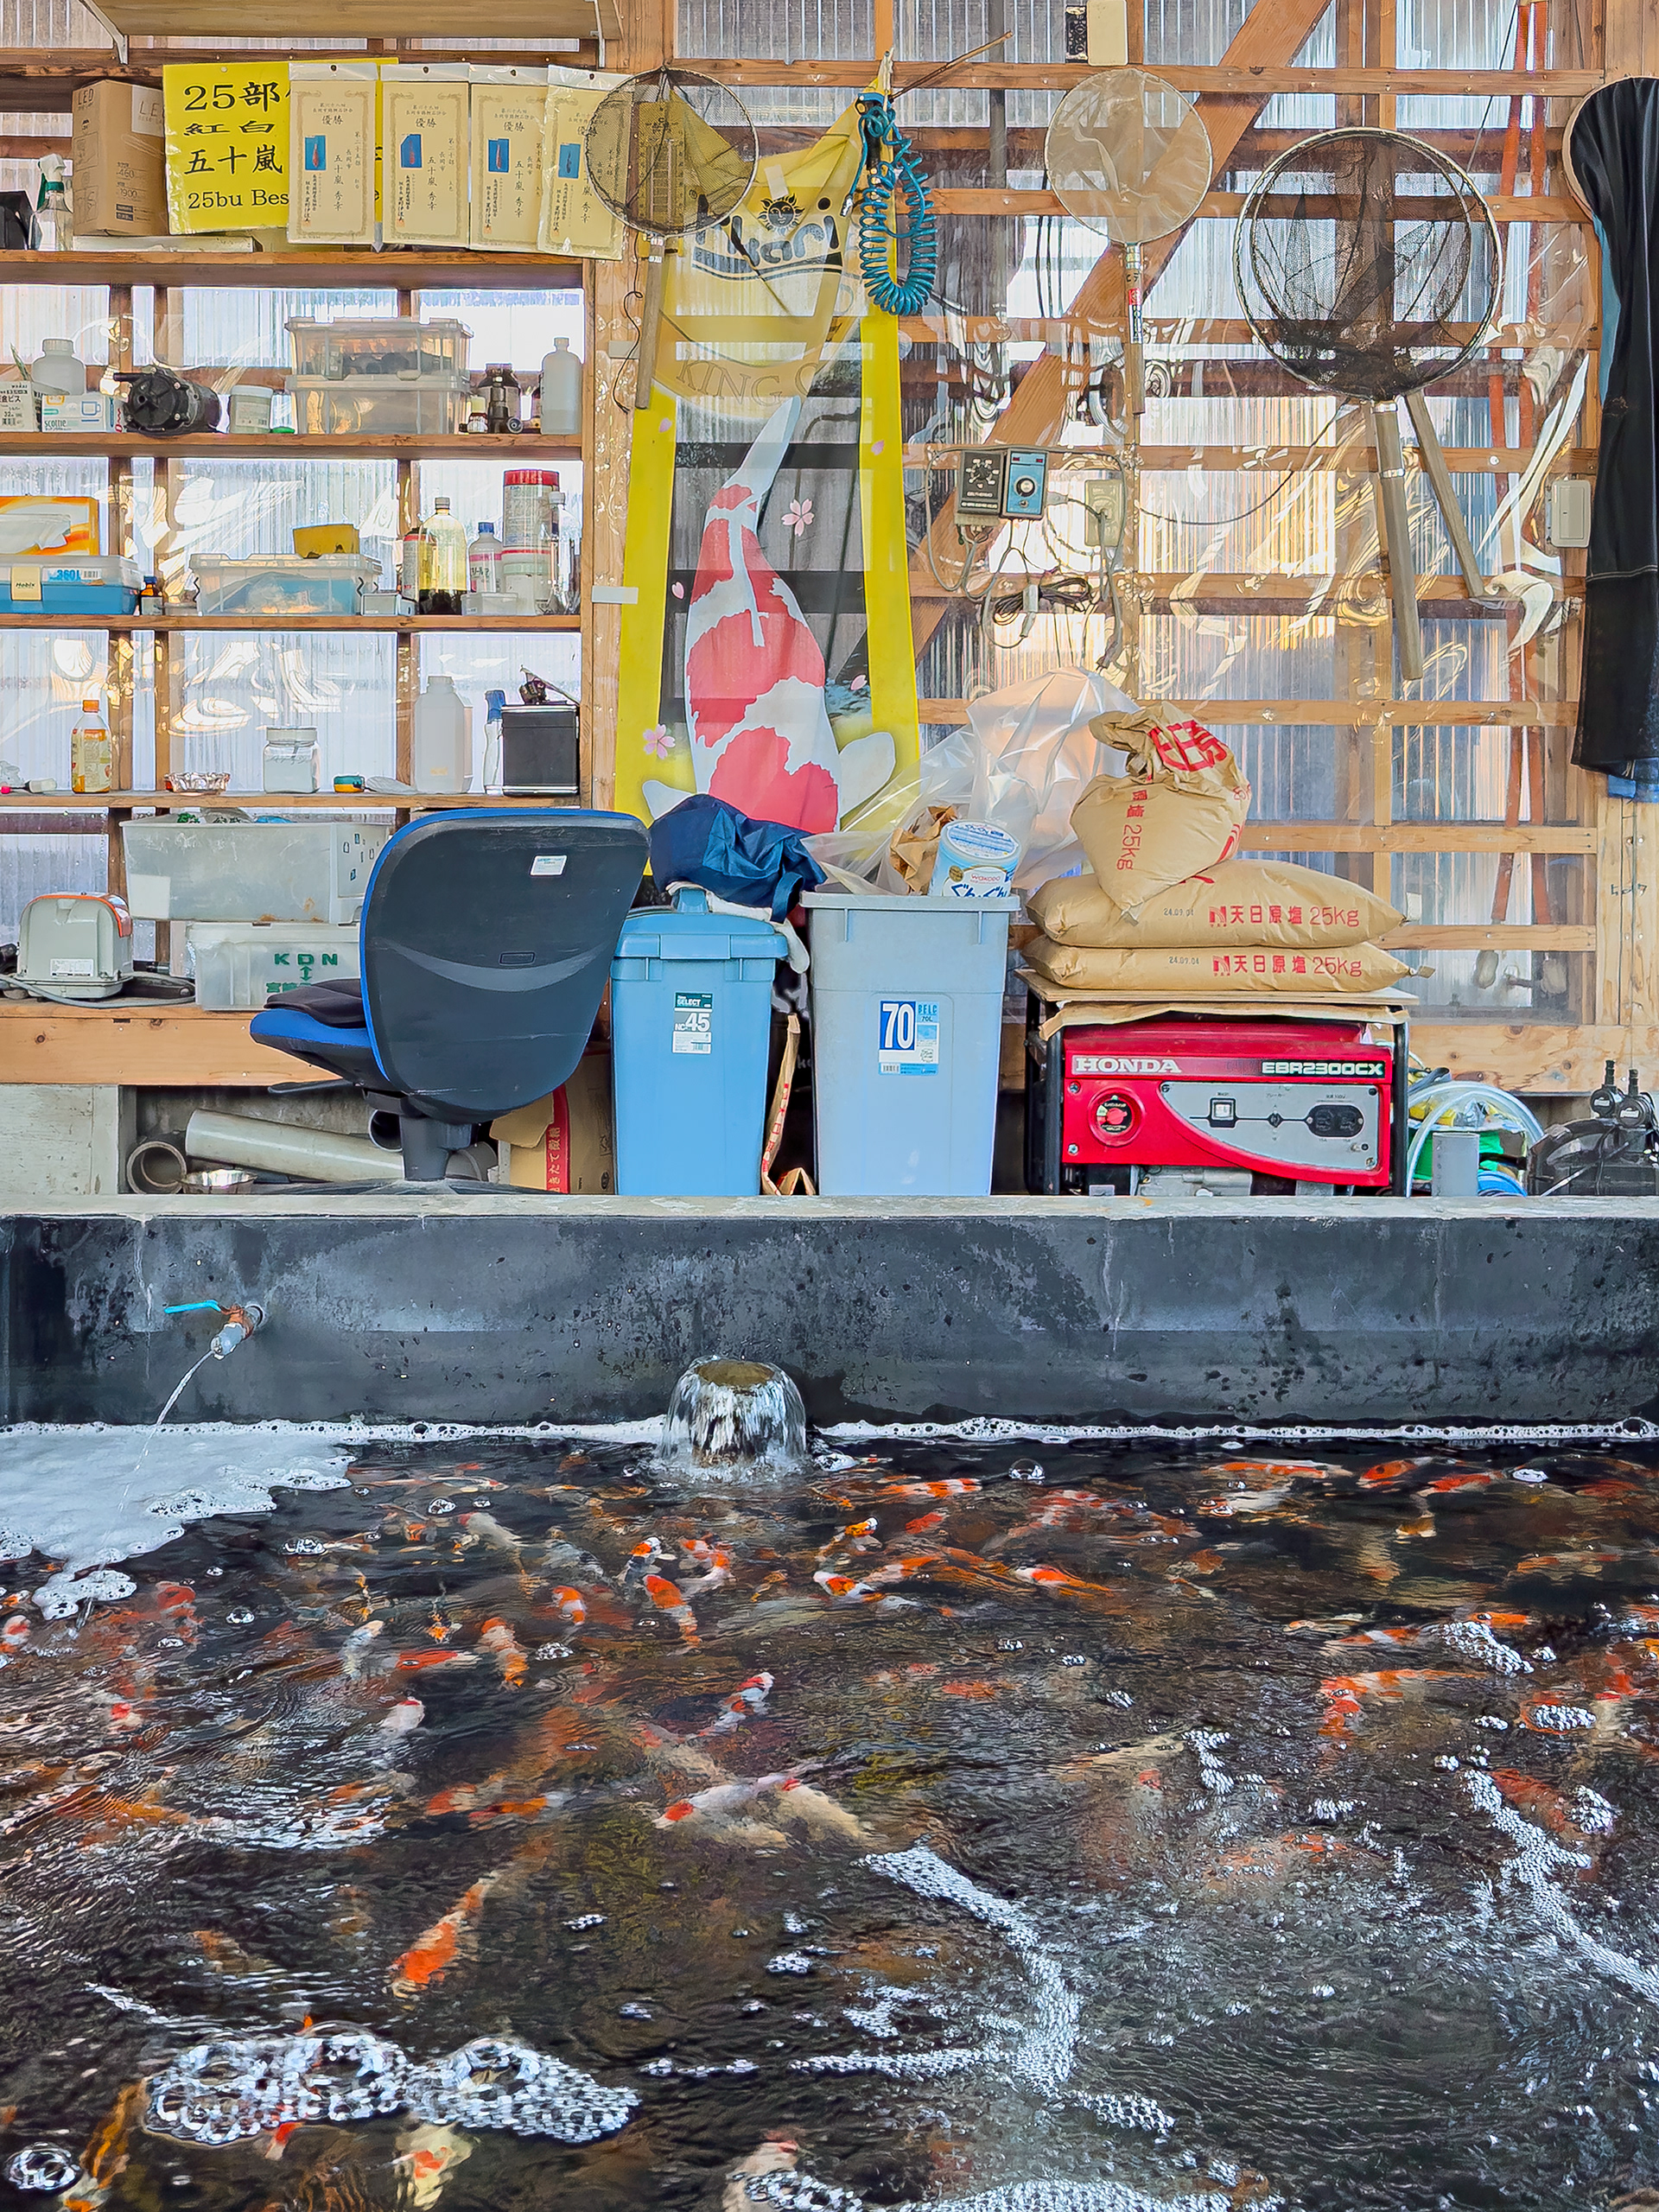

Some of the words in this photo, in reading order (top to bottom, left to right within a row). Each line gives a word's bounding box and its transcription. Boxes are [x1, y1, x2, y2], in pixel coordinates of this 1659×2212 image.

[184, 81, 280, 112] 25部
[139, 100, 160, 117] LE
[183, 120, 275, 137] 紅白
[321, 115, 343, 125] 優勝
[416, 118, 437, 128] 優勝
[504, 121, 524, 132] 優勝
[184, 143, 283, 175] 五十嵐
[334, 154, 344, 185] 五十嵐
[427, 156, 437, 187] 五十嵐
[514, 161, 524, 191] 五十嵐
[188, 192, 243, 209] 25bu
[251, 189, 289, 207] Bes
[676, 349, 783, 407] KING
[44, 417, 67, 428] scottie
[1127, 789, 1148, 818] 原塩
[1116, 823, 1142, 871] 25kg
[1230, 905, 1303, 925] 天日原塩
[1309, 906, 1360, 927] 25kg
[274, 953, 338, 965] KDN
[1234, 955, 1306, 974] 天日原塩
[1312, 957, 1363, 977] 25kg
[882, 1003, 915, 1049] 70
[1076, 1058, 1181, 1073] HONDA
[1262, 1061, 1382, 1076] EBR2300CX
